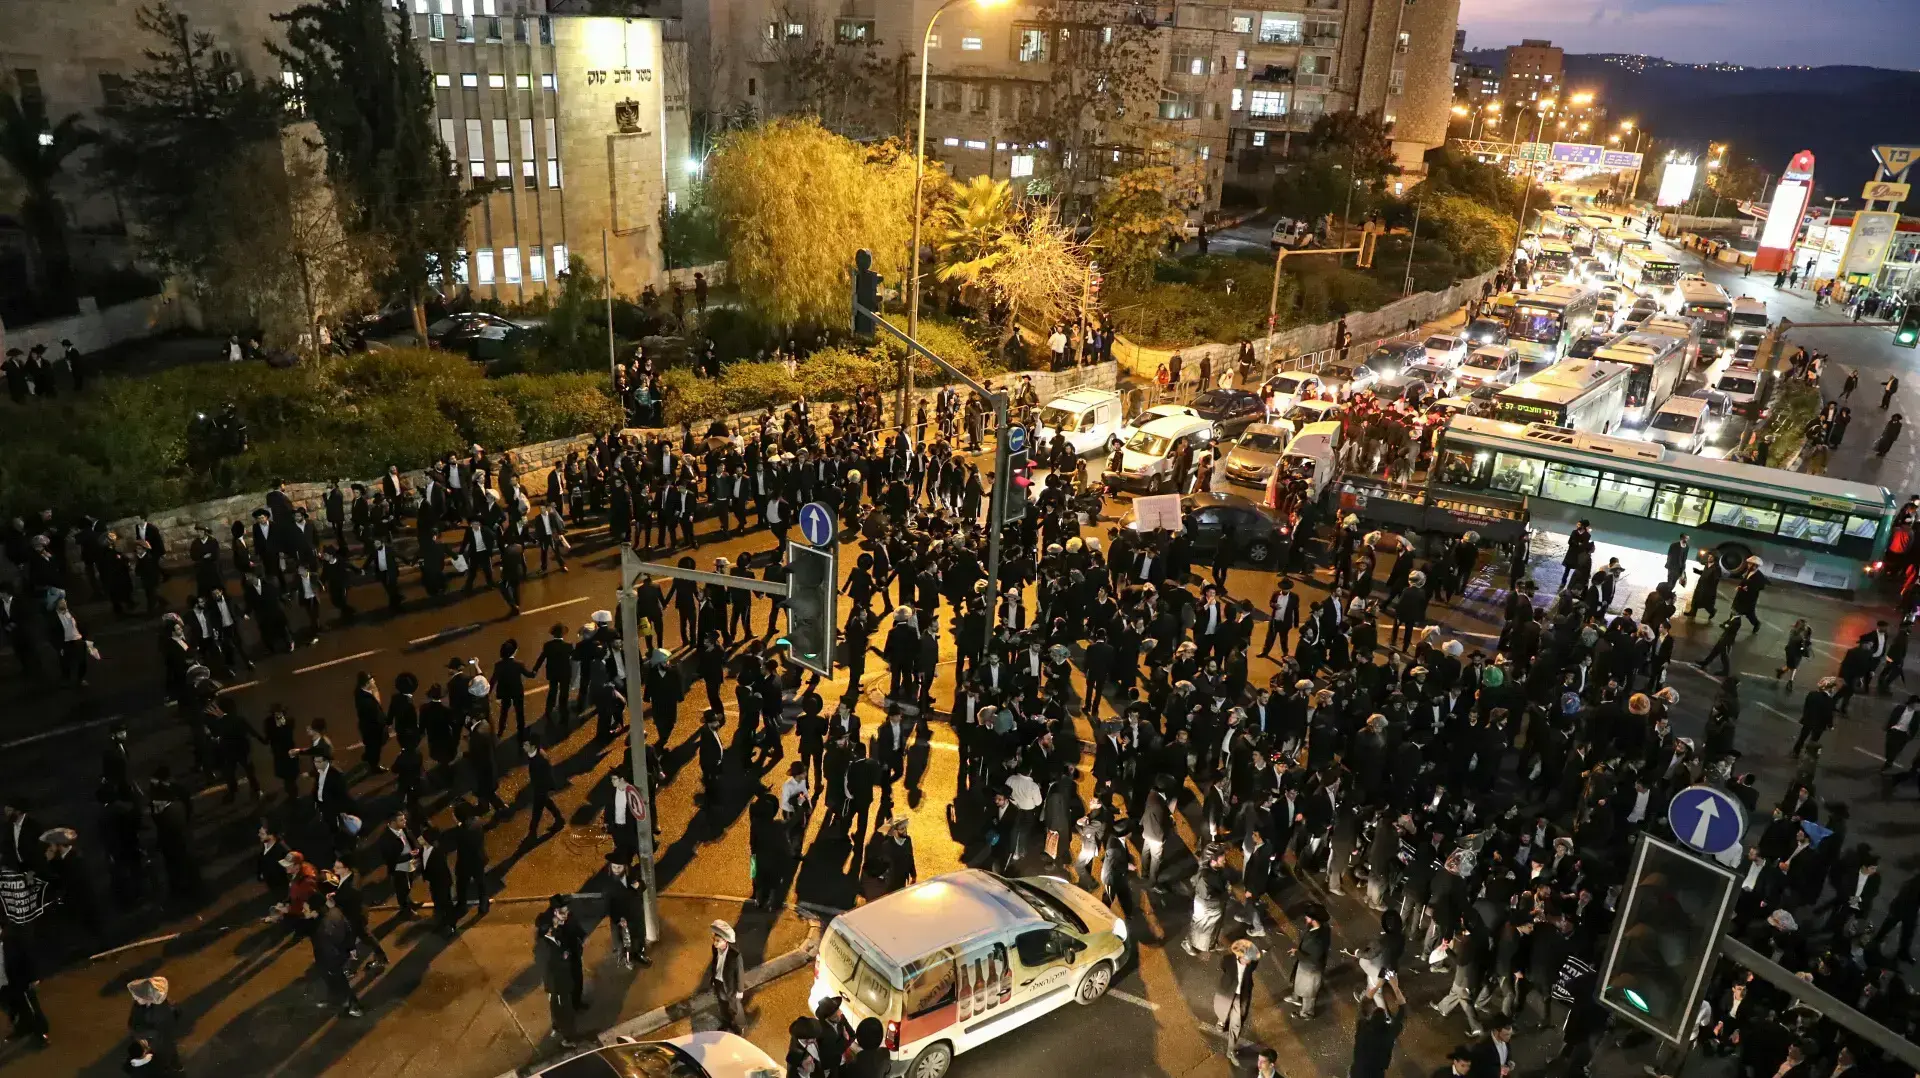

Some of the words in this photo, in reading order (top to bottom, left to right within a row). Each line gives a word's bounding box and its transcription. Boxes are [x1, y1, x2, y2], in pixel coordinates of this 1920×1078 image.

[587, 70, 606, 86] קוק
[614, 69, 631, 83] הרב
[1889, 150, 1911, 163] פז
[1505, 402, 1514, 410] 57
